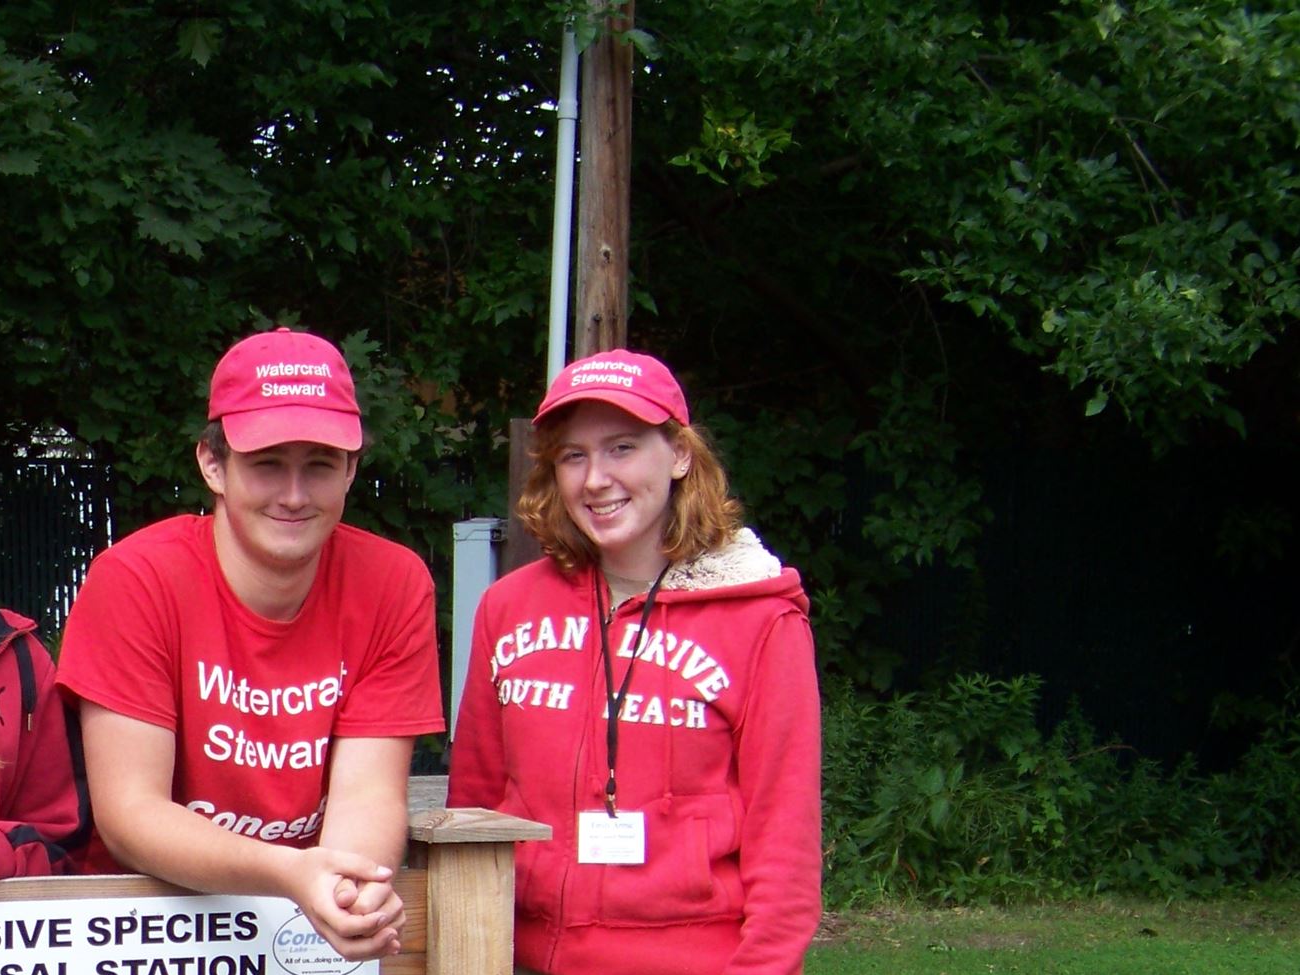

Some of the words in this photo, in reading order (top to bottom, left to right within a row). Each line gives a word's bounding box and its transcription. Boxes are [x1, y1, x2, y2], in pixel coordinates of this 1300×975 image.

[256, 362, 332, 379] Watercraft
[571, 373, 633, 388] Steward
[261, 382, 326, 397] Steward
[616, 623, 730, 703] DRIVE
[198, 661, 347, 716] Wtercrat
[498, 677, 575, 710] OUTH
[204, 724, 328, 769] Stewar
[86, 911, 259, 947] SPECIES
